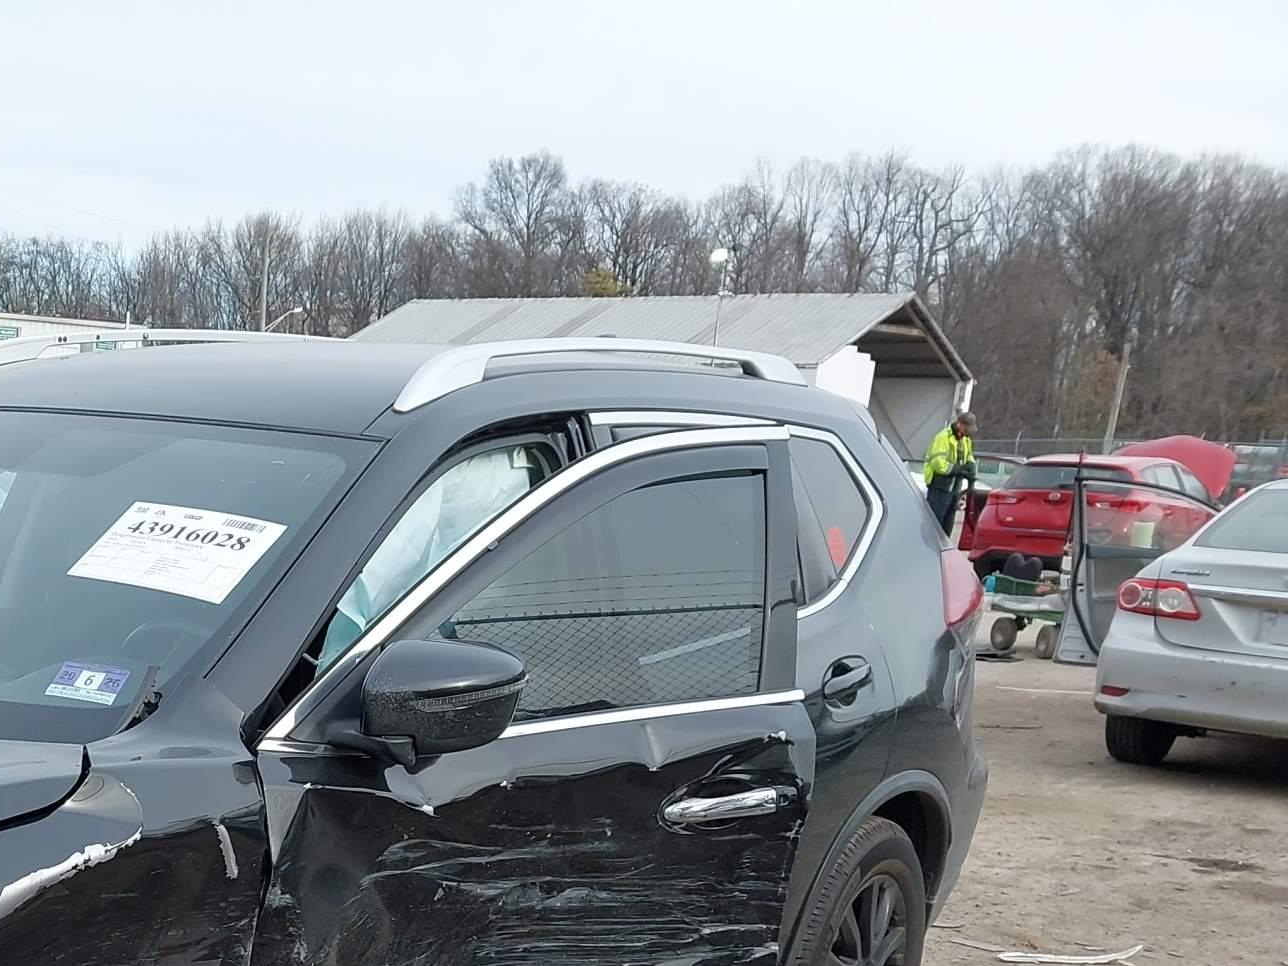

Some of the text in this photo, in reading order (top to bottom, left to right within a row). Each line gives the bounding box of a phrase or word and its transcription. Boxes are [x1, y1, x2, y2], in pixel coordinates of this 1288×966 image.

[127, 519, 251, 550] 43916028
[84, 674, 96, 686] 6
[104, 678, 121, 688] 26
